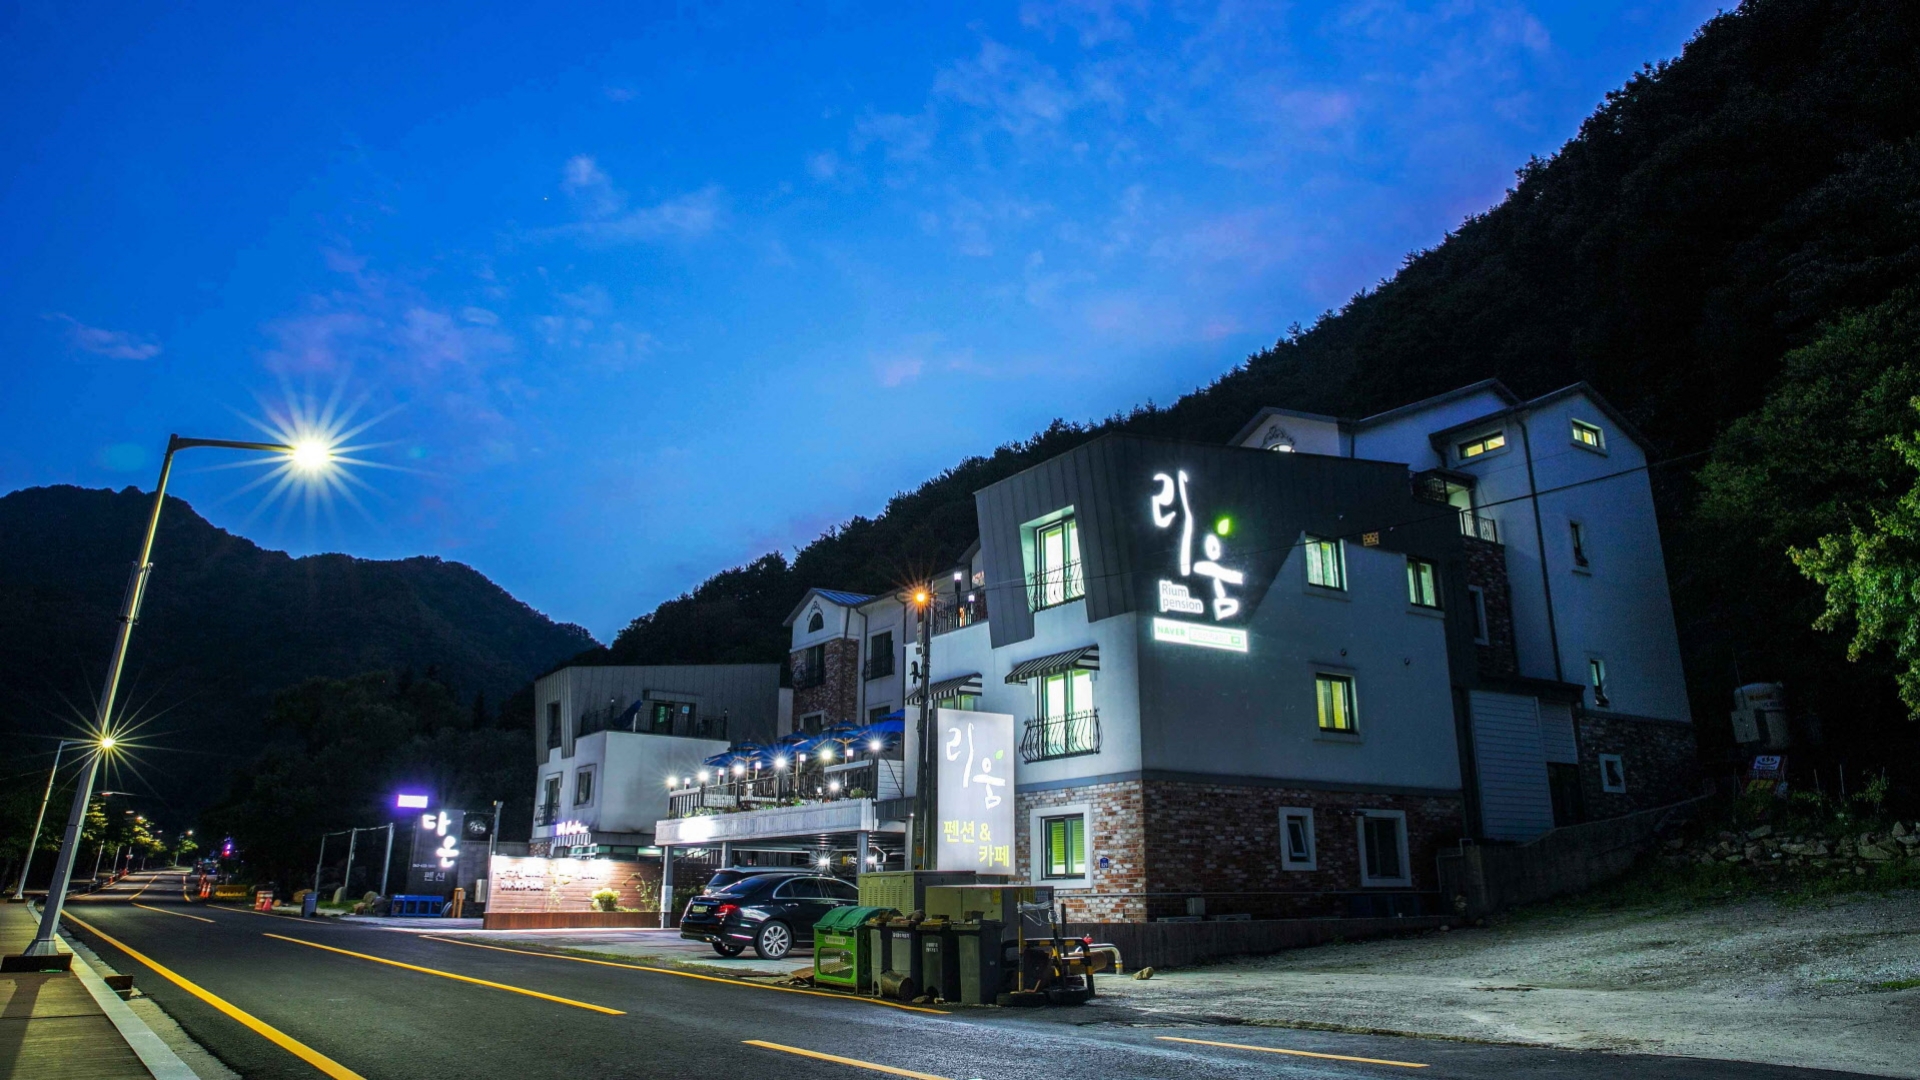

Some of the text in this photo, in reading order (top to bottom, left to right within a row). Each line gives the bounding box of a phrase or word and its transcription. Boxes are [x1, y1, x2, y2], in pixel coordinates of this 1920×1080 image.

[1152, 469, 1243, 621] 리움
[1161, 583, 1187, 598] Rium
[1162, 598, 1201, 611] pension
[1156, 626, 1186, 637] NAVER
[946, 722, 1005, 810] 리움
[944, 820, 991, 843] 펜션 &
[978, 844, 1010, 867] 카페
